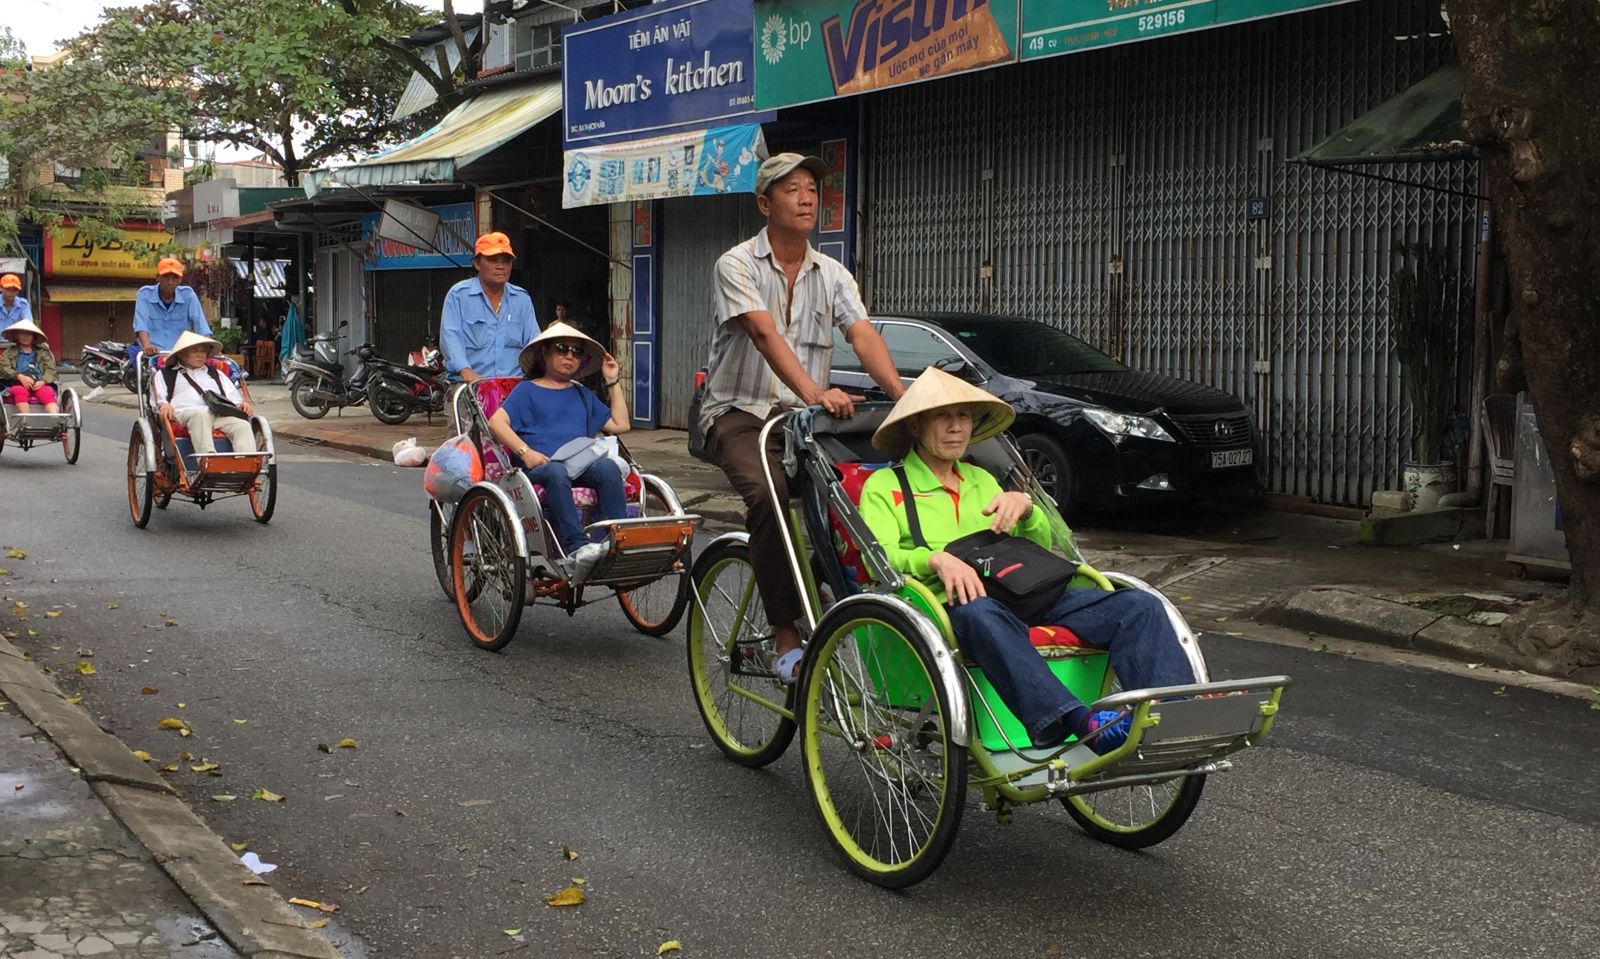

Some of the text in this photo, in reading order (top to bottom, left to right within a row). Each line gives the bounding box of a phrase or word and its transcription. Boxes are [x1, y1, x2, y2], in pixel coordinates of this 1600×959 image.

[789, 17, 811, 49] bp
[1138, 9, 1185, 32] 529156
[584, 49, 745, 109] Moon's kitchen
[1252, 201, 1264, 215] 82
